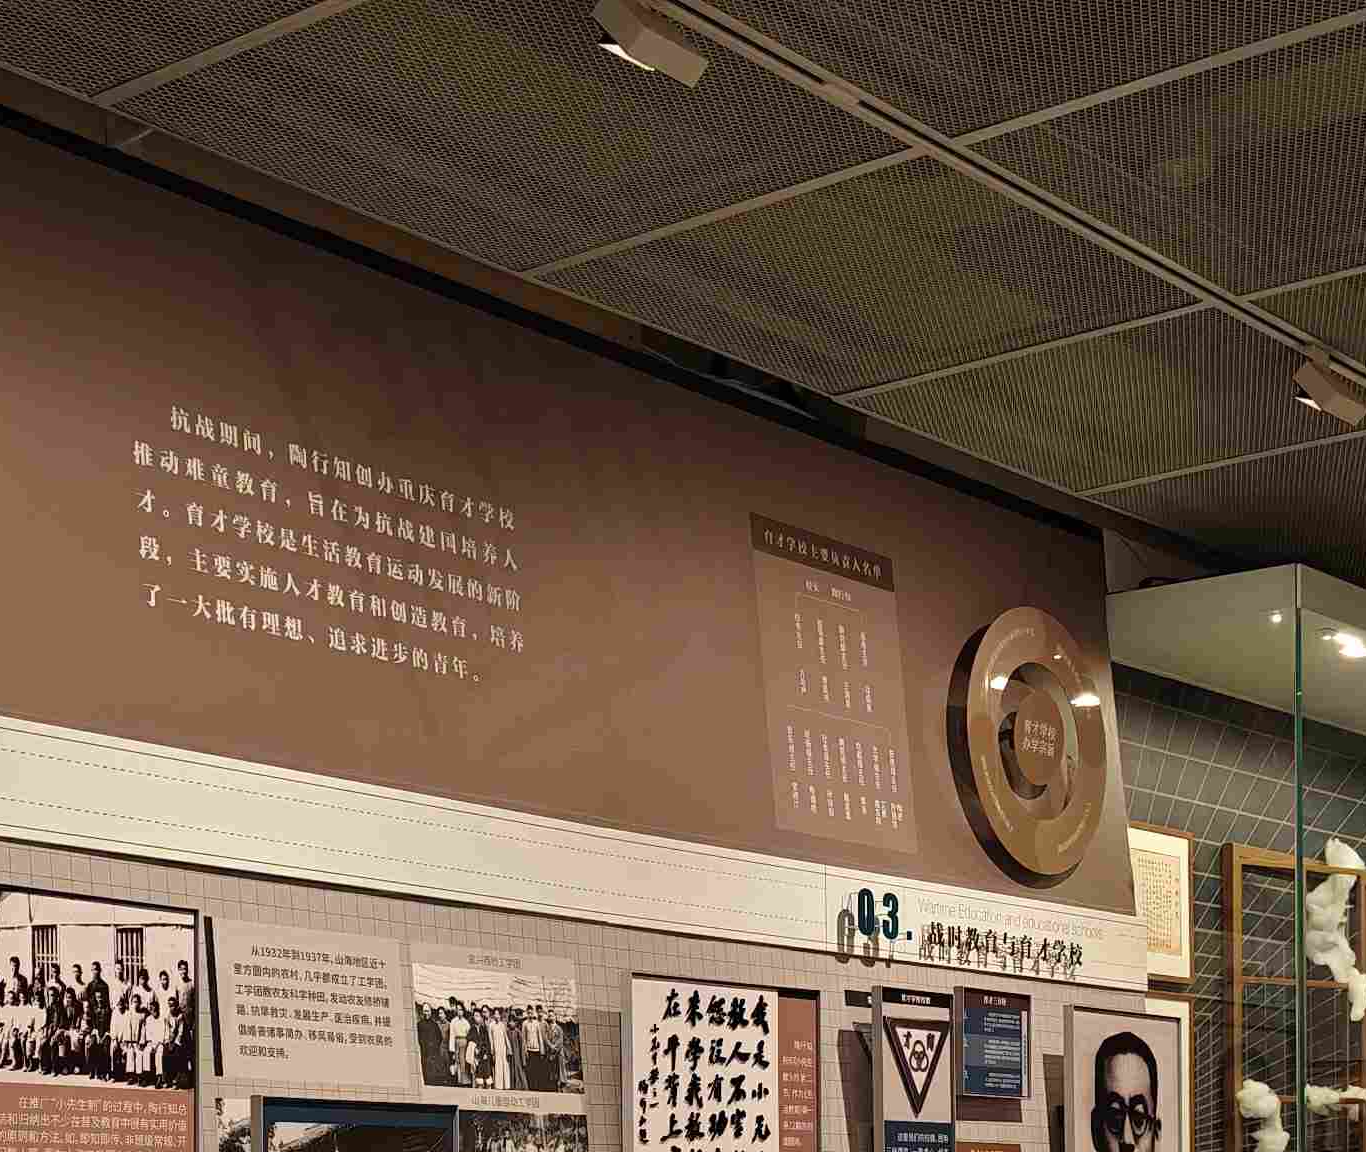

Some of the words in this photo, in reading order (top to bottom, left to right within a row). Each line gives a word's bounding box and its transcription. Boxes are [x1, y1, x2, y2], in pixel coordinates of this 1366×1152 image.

[133, 440, 518, 572] 推动难童教育，旨在为抗战建国培养人
[170, 405, 515, 531] 抗战期间，陶行知创办重庆育才学校
[137, 489, 522, 612] 才。育才学校是生活教育运动发展的新阶
[139, 536, 524, 653] 段，主要实施人才教育和创造教育，培养
[143, 583, 481, 683] 了一大批有理想、追求进步的青年。
[927, 921, 1084, 967] 战时教育与育才学校
